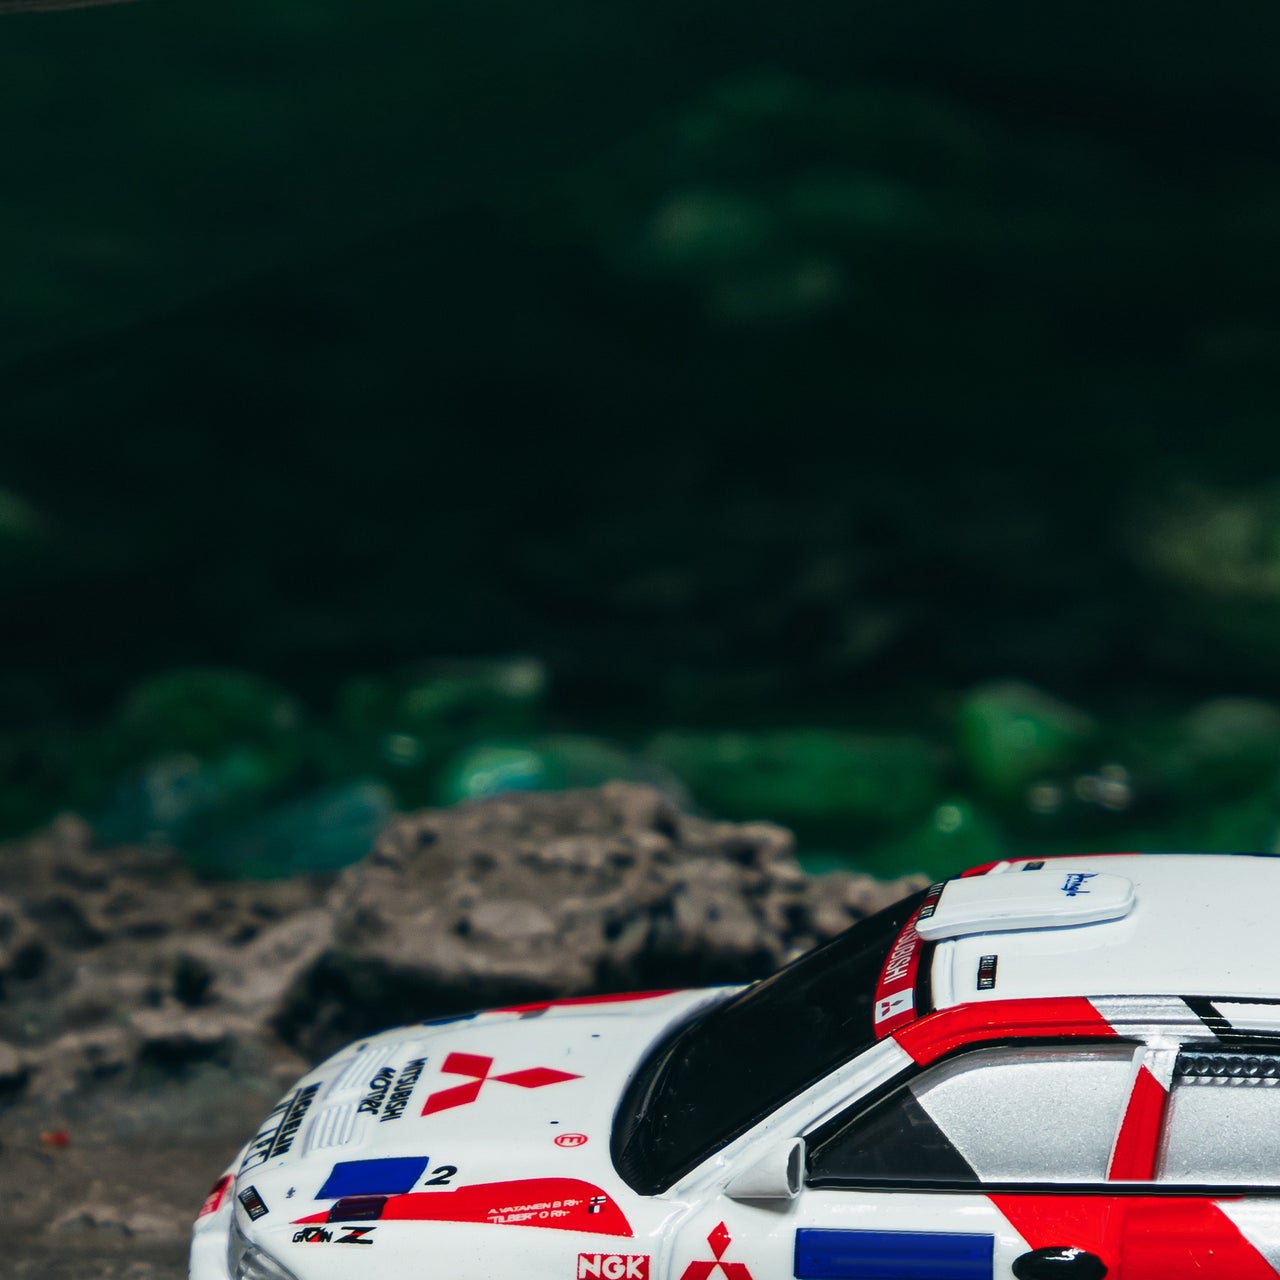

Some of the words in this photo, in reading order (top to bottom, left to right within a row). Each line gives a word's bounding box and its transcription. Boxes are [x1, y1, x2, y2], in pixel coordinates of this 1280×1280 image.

[357, 1066, 397, 1116] MOTORS
[379, 1057, 428, 1123] MITSUBISHI
[270, 1081, 324, 1159] MICHELIN
[424, 1165, 458, 1187] 2
[333, 1226, 377, 1245] Z
[578, 1255, 645, 1280] NGK
